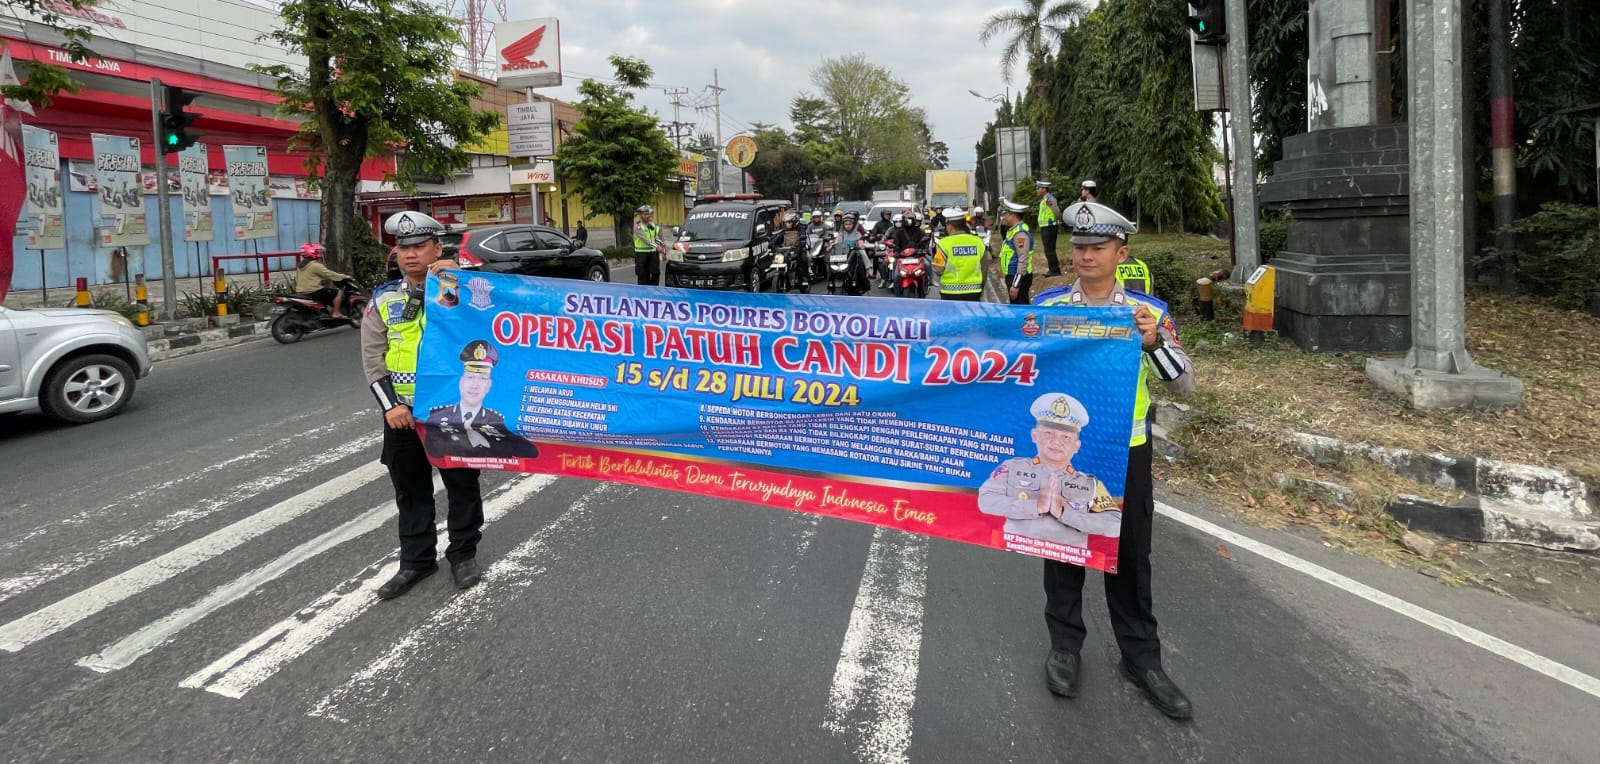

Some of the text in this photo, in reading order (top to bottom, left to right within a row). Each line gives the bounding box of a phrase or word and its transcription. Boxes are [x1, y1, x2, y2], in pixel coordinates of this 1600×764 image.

[48, 50, 121, 72] TIMUL JAYA
[501, 60, 548, 71] HONDA
[97, 162, 139, 172] PROGRAM
[98, 153, 138, 165] SPECIAL
[230, 161, 265, 170] SPECIAL
[527, 172, 549, 181] Wing
[690, 212, 748, 221] AMBULANCE
[953, 247, 977, 256] POLISI
[1118, 266, 1146, 278] POLISI
[565, 294, 928, 340] SATLANTAS POLRES BOYOLALI
[1046, 322, 1133, 338] PRESISI
[493, 312, 1039, 386] OPERASI PATUH CANDI 2024
[530, 371, 604, 386] SASARAN KHUSUS
[616, 361, 860, 406] 15 s/d 28 JULI 2024
[530, 386, 558, 395] MELAWAN
[559, 389, 574, 397] ARUS
[529, 395, 545, 403] TIDAK
[546, 397, 589, 409] MENGGUNAKAN
[591, 402, 607, 411] HELM
[607, 404, 618, 412] SNI
[526, 405, 552, 414] MELEBIHI
[553, 408, 571, 417] BATAS
[573, 410, 606, 421] KECEPATAN
[707, 405, 731, 415] SEPEDA
[732, 408, 755, 417] MOTOR
[756, 410, 810, 420] BERBONCENGAN
[523, 415, 561, 426] BERKENDARA
[562, 419, 589, 429] DIBAWAH
[590, 422, 608, 432] UMUR
[706, 416, 745, 425] KENDARAAN
[856, 417, 877, 425] TIDAK
[878, 419, 916, 428] MEMENUHI
[917, 422, 968, 436] PERSYARATAN
[970, 430, 988, 440] LAIK
[988, 435, 1014, 445] JALAN
[808, 429, 828, 437] TIDAK
[829, 431, 870, 441] DILENGKAPI
[871, 435, 900, 446] DENGAN
[901, 439, 948, 453] SURAT-SURAT
[949, 448, 999, 463] BERKENDARA
[829, 423, 870, 432] DILENGKAPI
[871, 426, 900, 437] DENGAN
[901, 430, 957, 445] PERLENGKAPAN
[959, 438, 979, 449] YANG
[980, 443, 1015, 456] STANDAR
[717, 445, 772, 456] PERUNTUKANNYA
[794, 436, 830, 445] BERMOTOR
[831, 440, 850, 448] YANG
[851, 442, 893, 455] MELANGGAR
[894, 448, 940, 463] MARKA/BAHU
[941, 457, 964, 467] JALAN
[756, 441, 791, 450] BERMOTOR
[792, 444, 810, 453] YANG
[811, 446, 849, 458] MEMASANG
[850, 451, 880, 463] ROTATOR
[881, 456, 899, 466] ATAU
[900, 459, 923, 470] SIRINE
[924, 463, 944, 474] YANG
[945, 467, 971, 479] BUKAN
[1016, 471, 1037, 479] EKO
[558, 454, 936, 525] Tertib Berlalulintas Demi Terwujudnya Indonesia Emas
